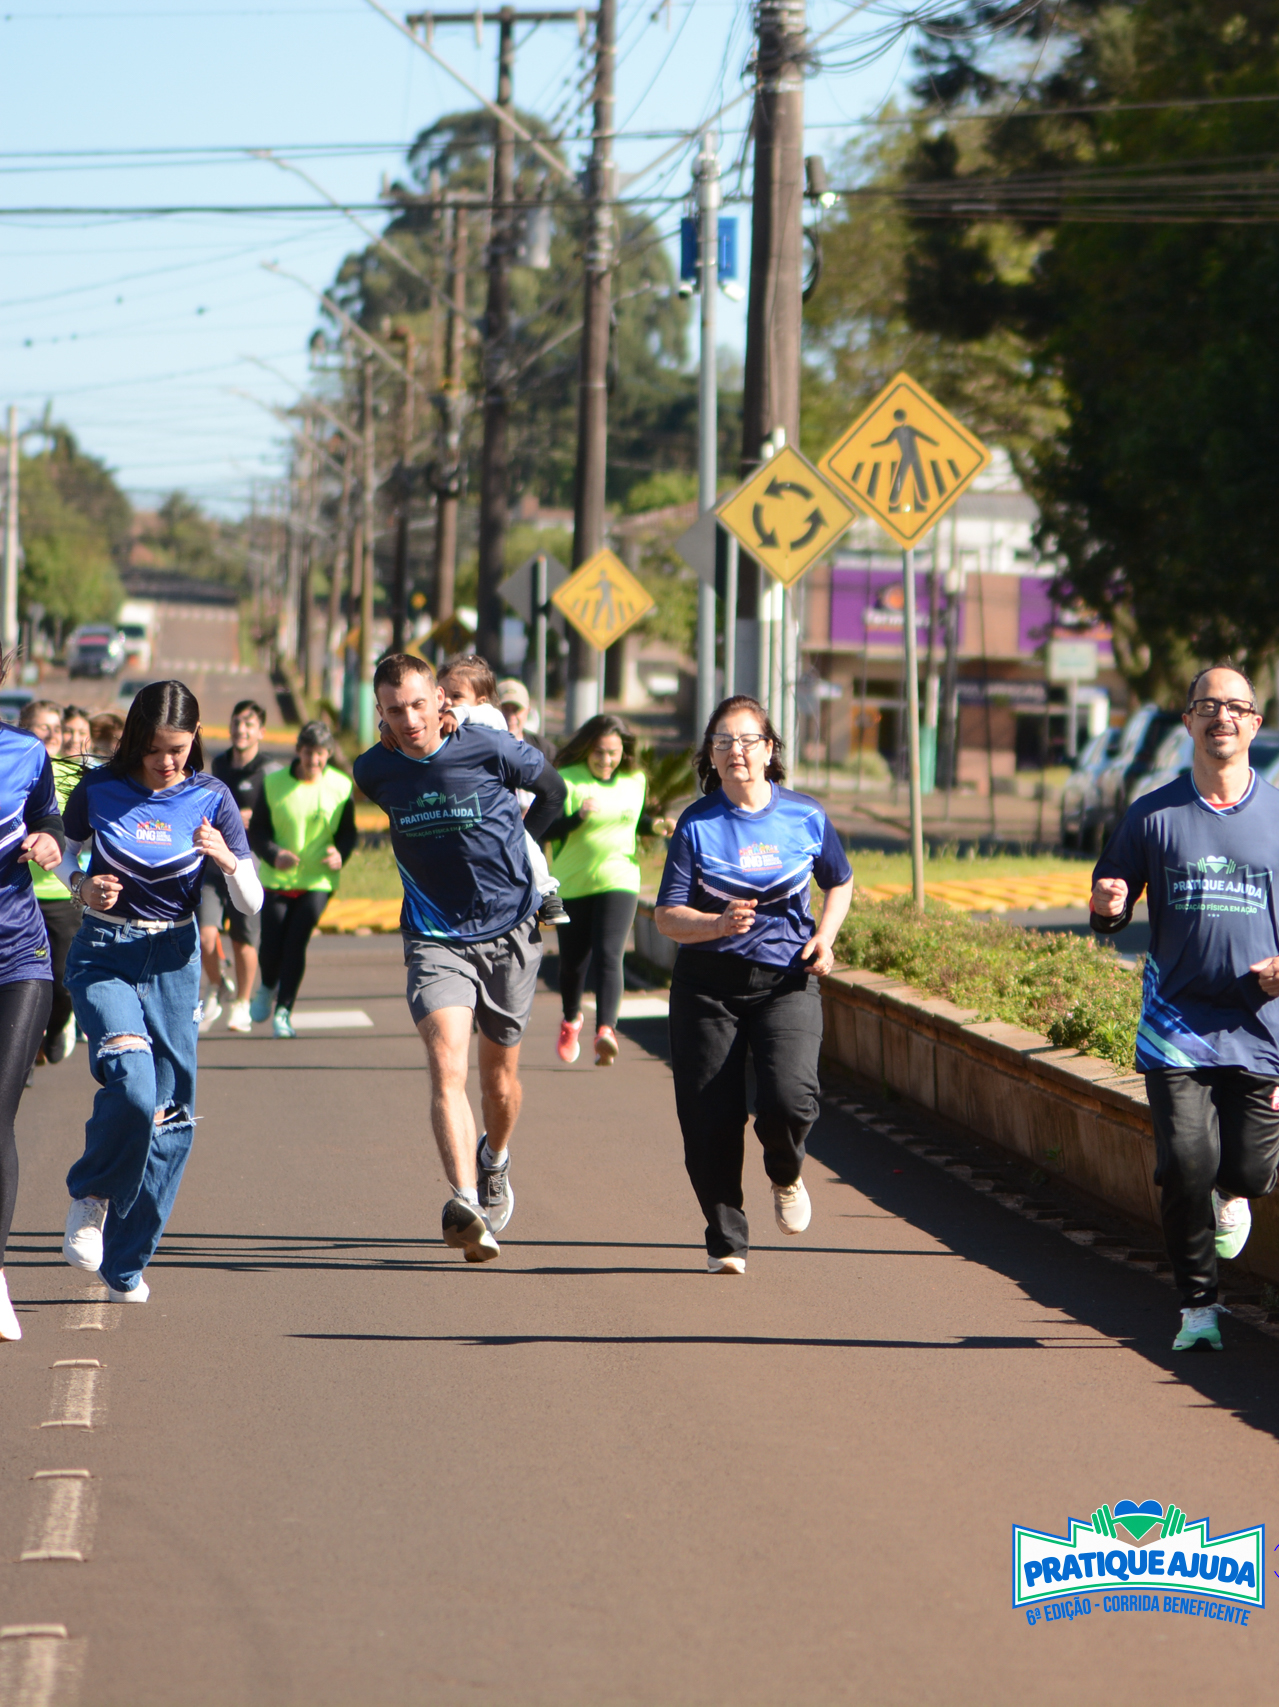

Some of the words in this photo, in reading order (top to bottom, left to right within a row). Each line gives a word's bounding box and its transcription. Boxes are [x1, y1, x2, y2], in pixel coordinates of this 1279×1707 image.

[400, 810, 441, 825] PRATIQUE
[443, 808, 474, 818] AJUDA
[136, 829, 156, 841] ONG
[739, 855, 763, 868] ONG
[1173, 880, 1225, 892] PRATIQUE
[1226, 882, 1262, 899] AJUDA
[1175, 903, 1206, 912] EDUCAÇÃO
[1206, 903, 1229, 911] FÍSICA
[1240, 906, 1258, 915] AÇÃO
